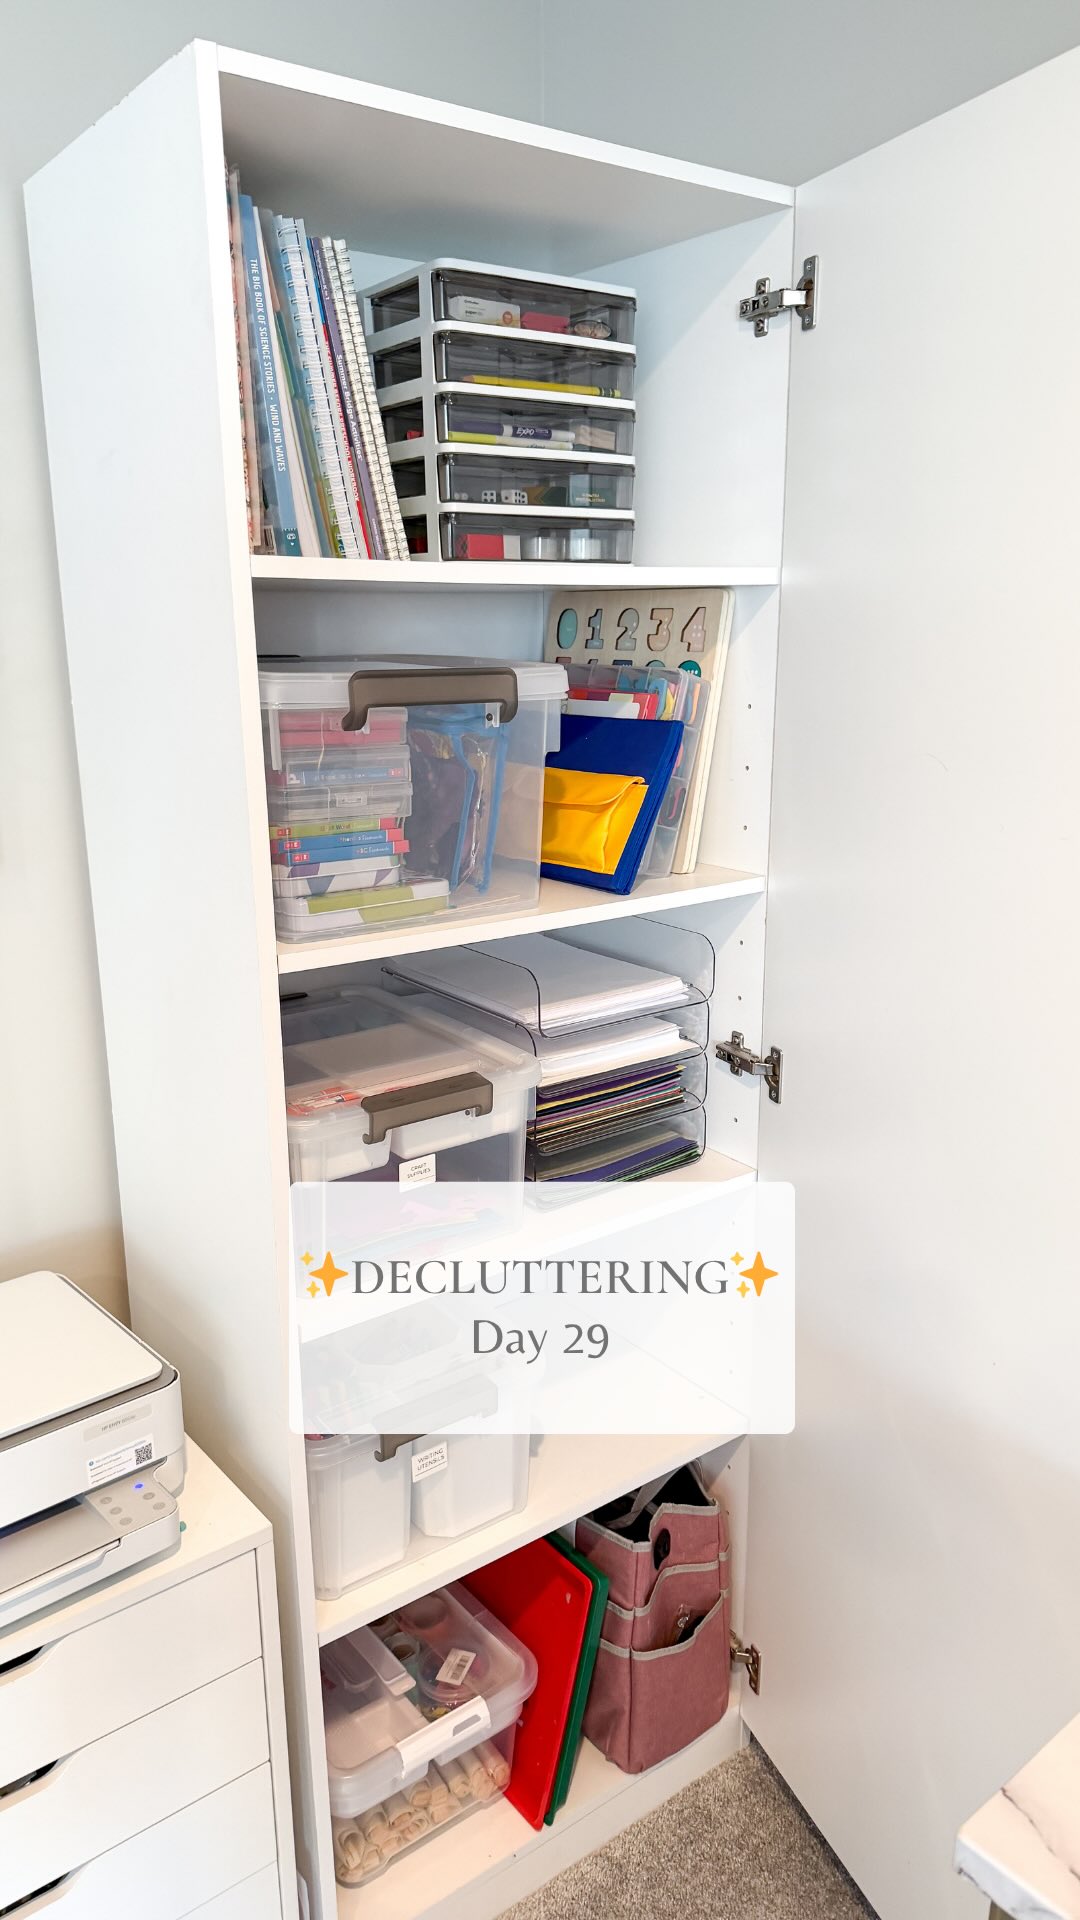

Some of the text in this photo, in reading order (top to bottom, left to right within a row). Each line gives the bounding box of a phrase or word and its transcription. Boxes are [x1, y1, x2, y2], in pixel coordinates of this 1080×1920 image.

[250, 258, 286, 472] THE BIG BOOK OF SCIENCE STORIES WIND AND WAVES
[336, 354, 348, 392] Summer
[344, 391, 354, 420] Bridge
[348, 460, 360, 502] WORKBOOK
[407, 1168, 431, 1178] SUPPLIES
[411, 1163, 427, 1171] CRAFT
[418, 1448, 443, 1463] WRITING
[418, 1455, 444, 1470] UTENSILS
